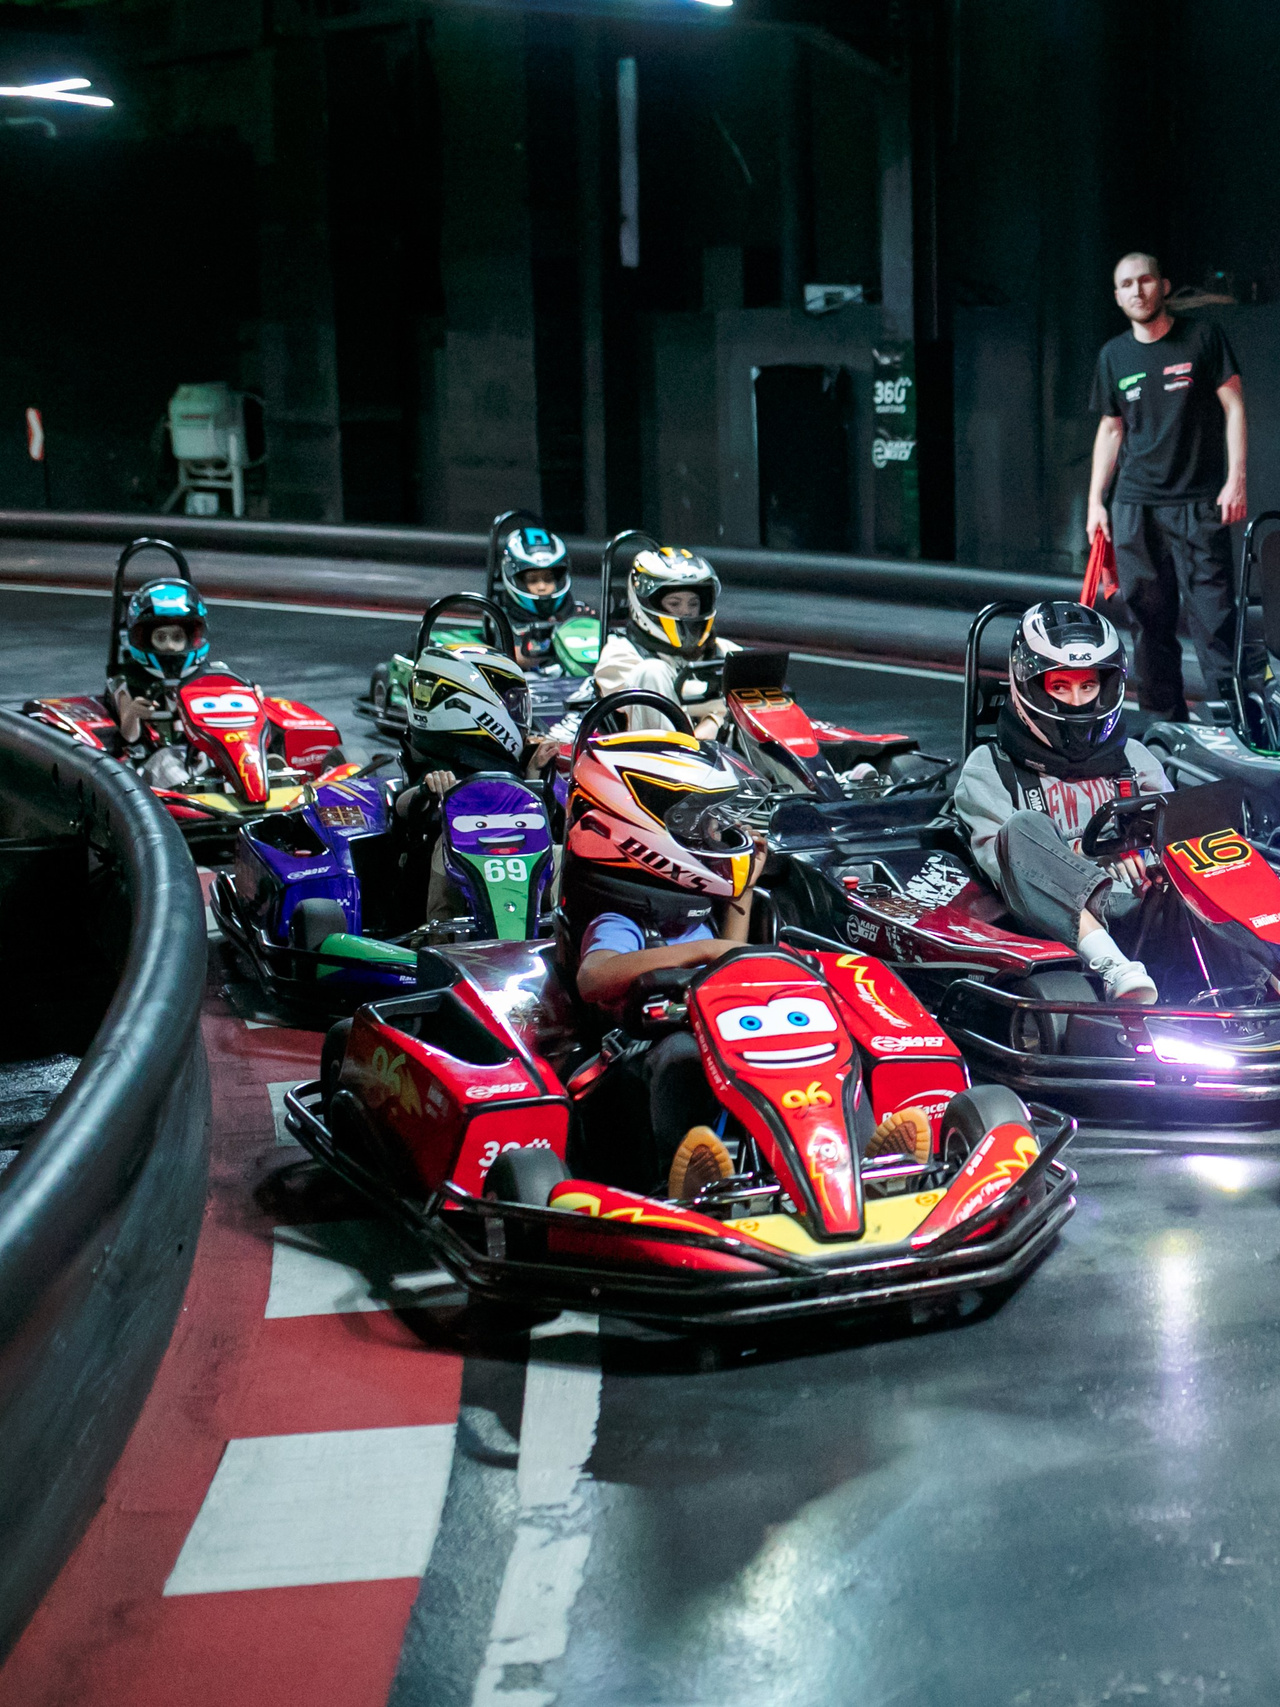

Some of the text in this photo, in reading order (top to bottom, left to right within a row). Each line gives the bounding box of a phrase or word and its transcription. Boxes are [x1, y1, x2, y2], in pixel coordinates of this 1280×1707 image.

[873, 379, 911, 404] 360
[876, 405, 906, 413] KARTING
[1028, 789, 1043, 812] OMP
[1168, 827, 1252, 873] 16
[484, 858, 527, 882] 69
[619, 836, 713, 891] BOX'S
[781, 1081, 832, 1109] 96
